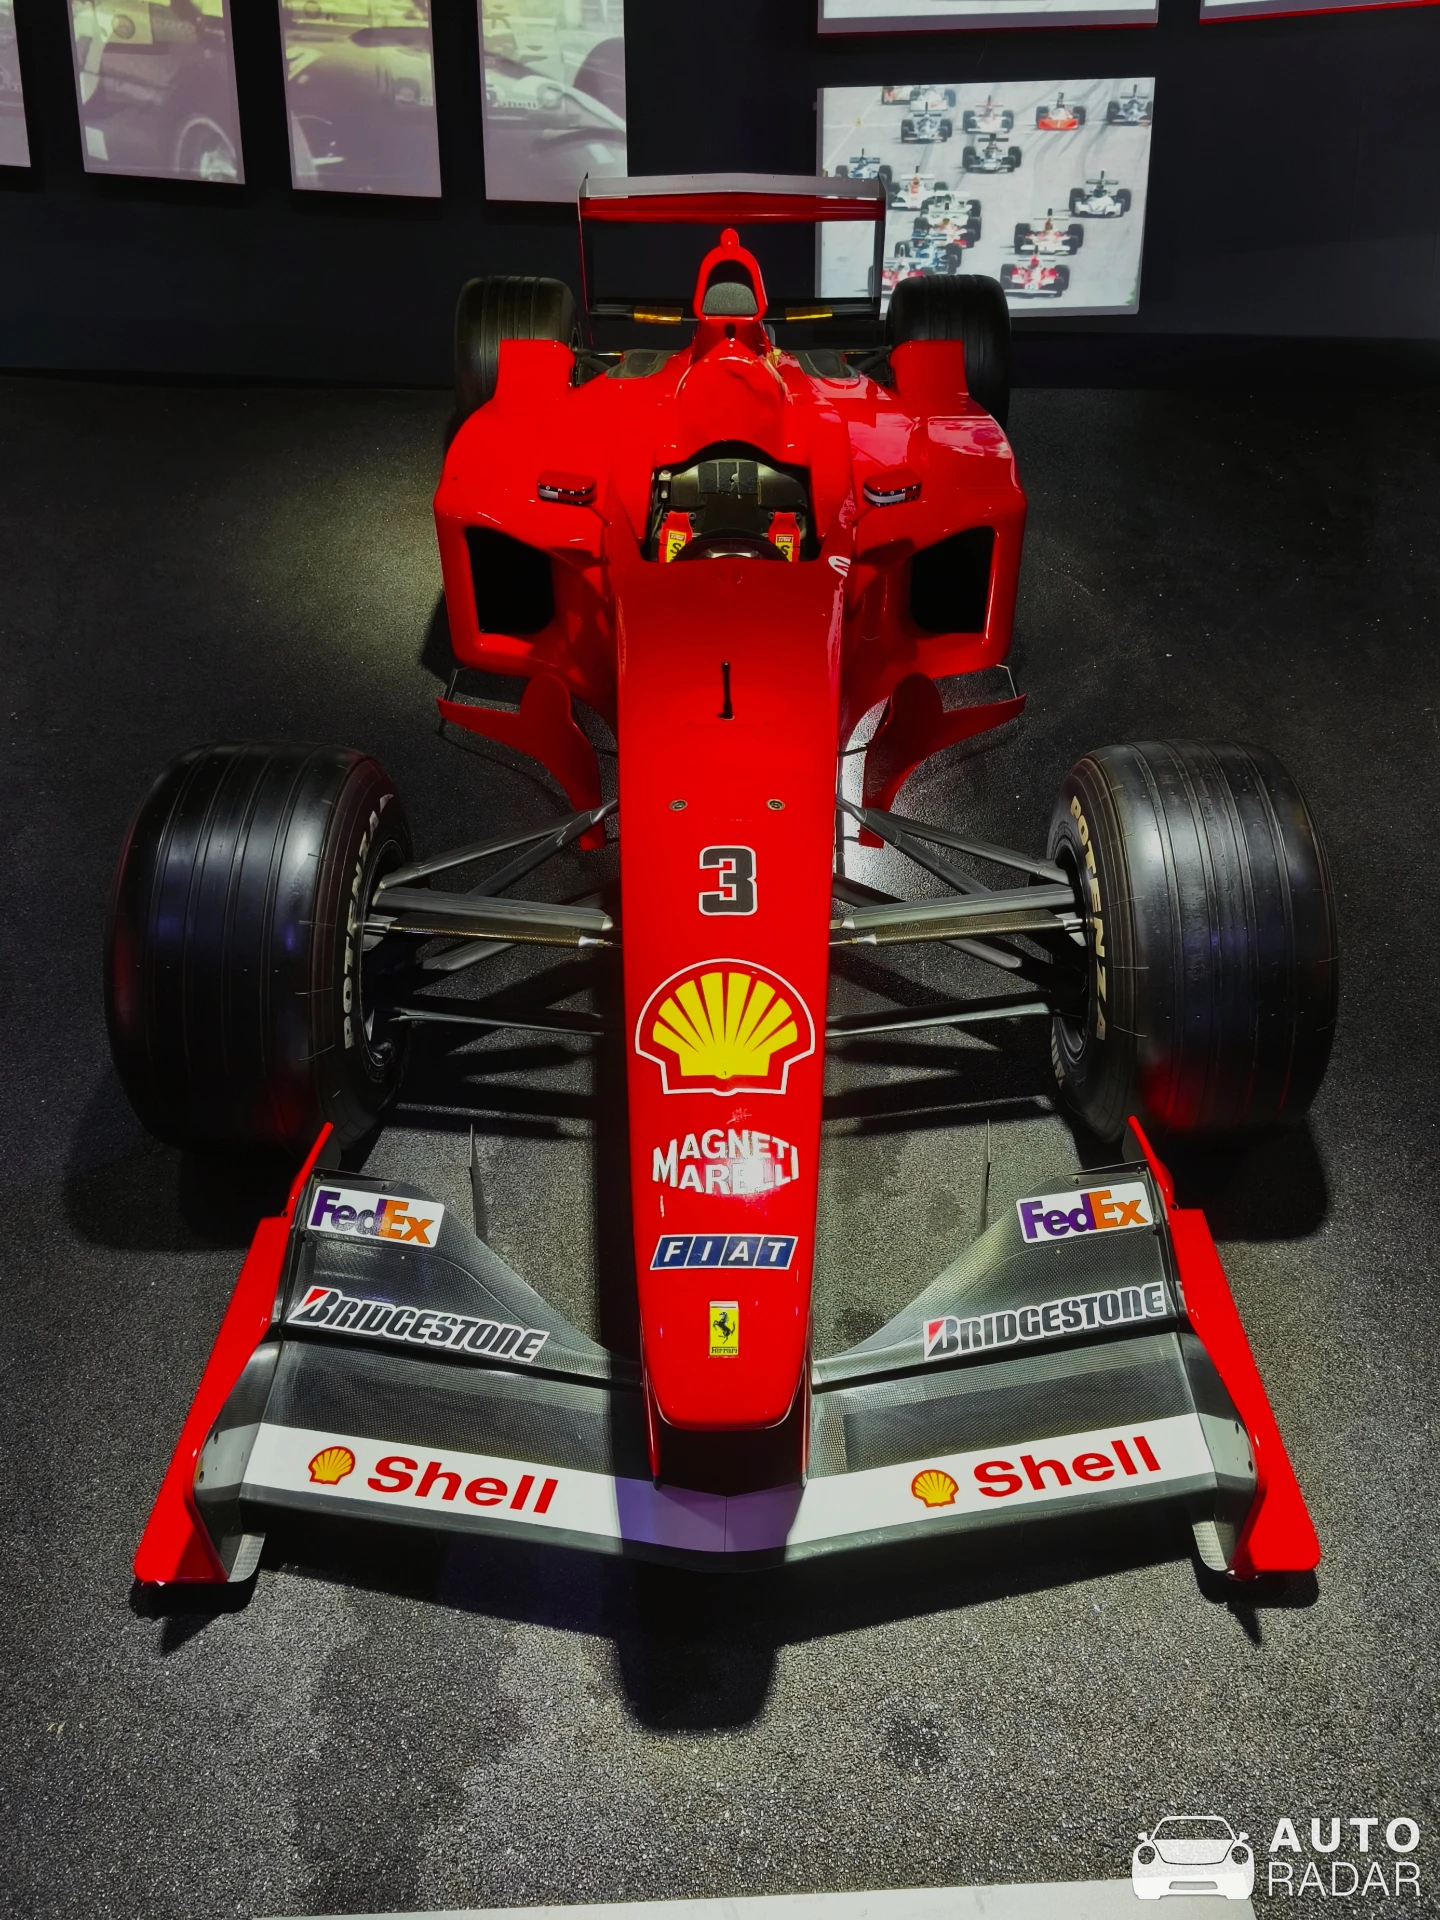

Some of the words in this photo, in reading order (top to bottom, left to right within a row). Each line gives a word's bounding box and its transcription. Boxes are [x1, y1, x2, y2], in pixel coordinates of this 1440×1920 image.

[698, 845, 758, 916] 3
[1060, 795, 1107, 1041] POTENZA
[652, 1129, 799, 1180] MAGNETI
[652, 1146, 799, 1195] MARELLI
[310, 1190, 434, 1244] FedEx
[1020, 1190, 1148, 1239] FedEx
[664, 1240, 787, 1263] FIAT
[294, 1288, 548, 1360] BRIDGESTONE
[927, 1284, 1164, 1357] BRIDGESTONE
[711, 1346, 738, 1354] Ferrari
[367, 1456, 559, 1514] Shell
[973, 1436, 1161, 1498] Shell
